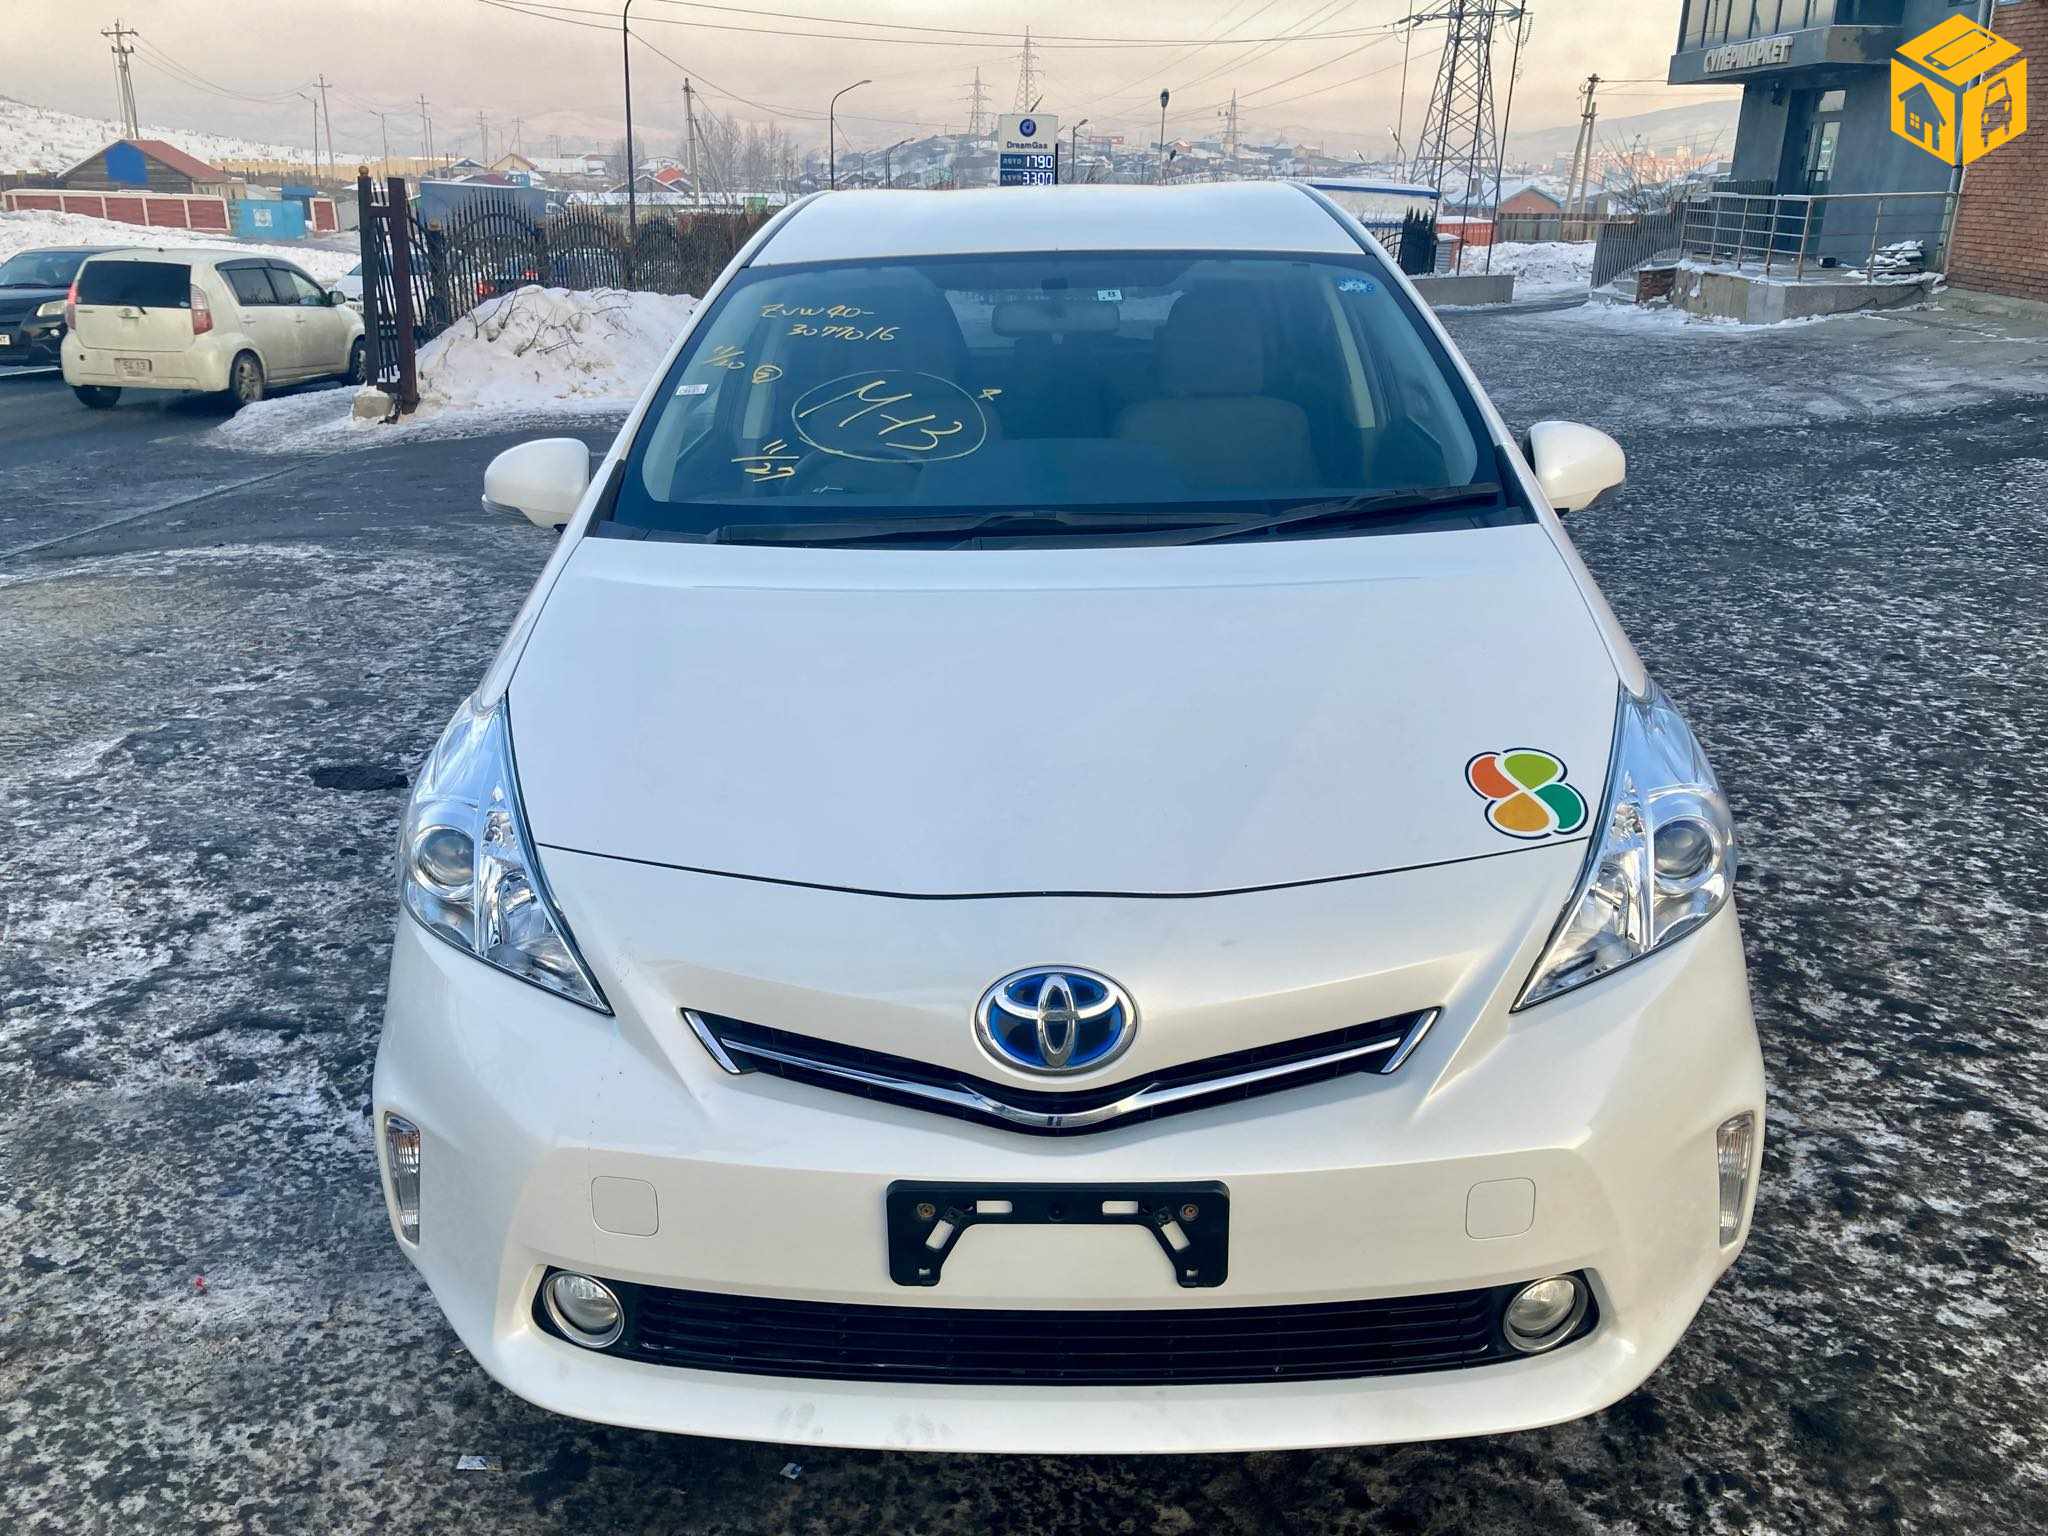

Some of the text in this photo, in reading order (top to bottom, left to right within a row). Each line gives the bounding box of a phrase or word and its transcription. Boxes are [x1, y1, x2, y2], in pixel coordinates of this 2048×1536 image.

[1704, 36, 1793, 72] СУПЕРМАРКЕТ
[1006, 141, 1048, 149] DreamGas
[1026, 155, 1053, 169] 1790
